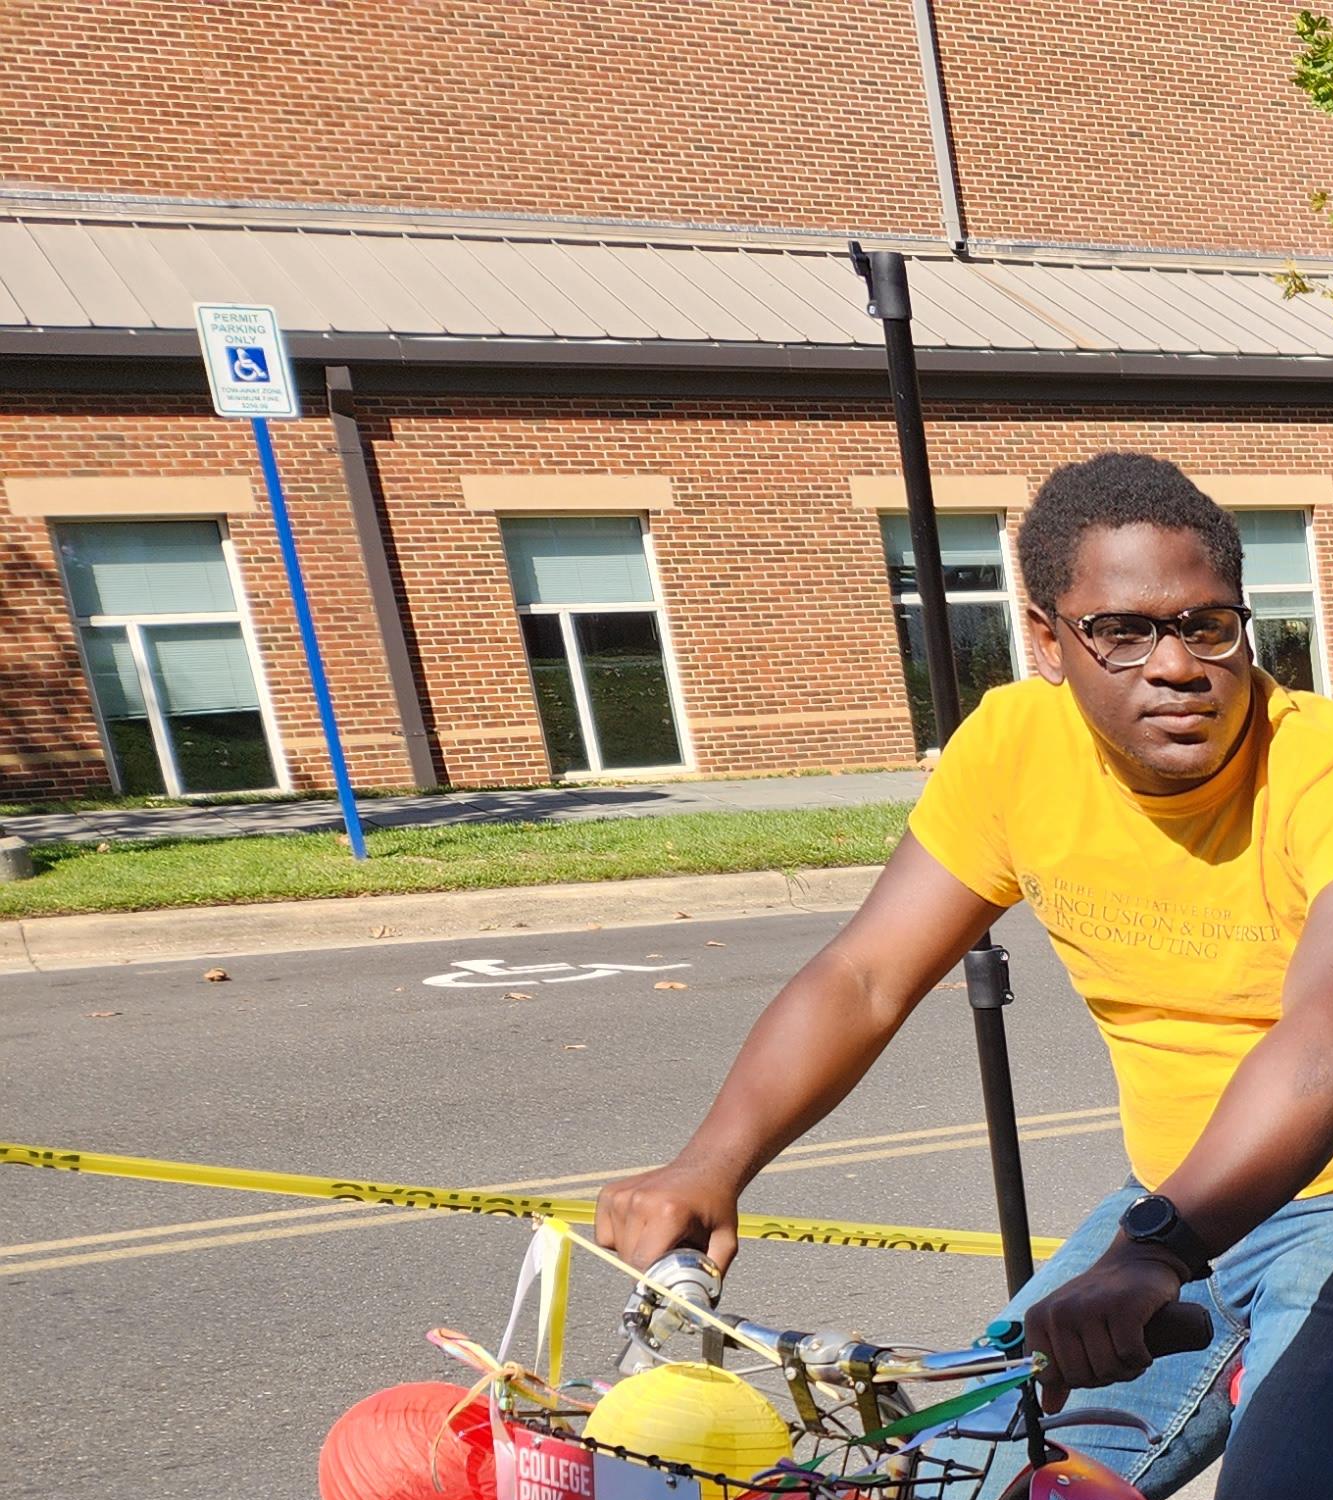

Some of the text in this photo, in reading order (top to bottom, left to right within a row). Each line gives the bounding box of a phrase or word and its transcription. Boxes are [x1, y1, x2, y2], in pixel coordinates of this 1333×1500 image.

[213, 312, 259, 323] PERMIT
[211, 323, 266, 334] PARKING
[225, 335, 257, 345] ONLY
[1053, 893, 1175, 934] INCLUSION
[1180, 921, 1193, 936] &
[1204, 907, 1233, 920] FOR
[1055, 911, 1219, 960] IN COMPUTING
[519, 1447, 592, 1497] COLLEGE
